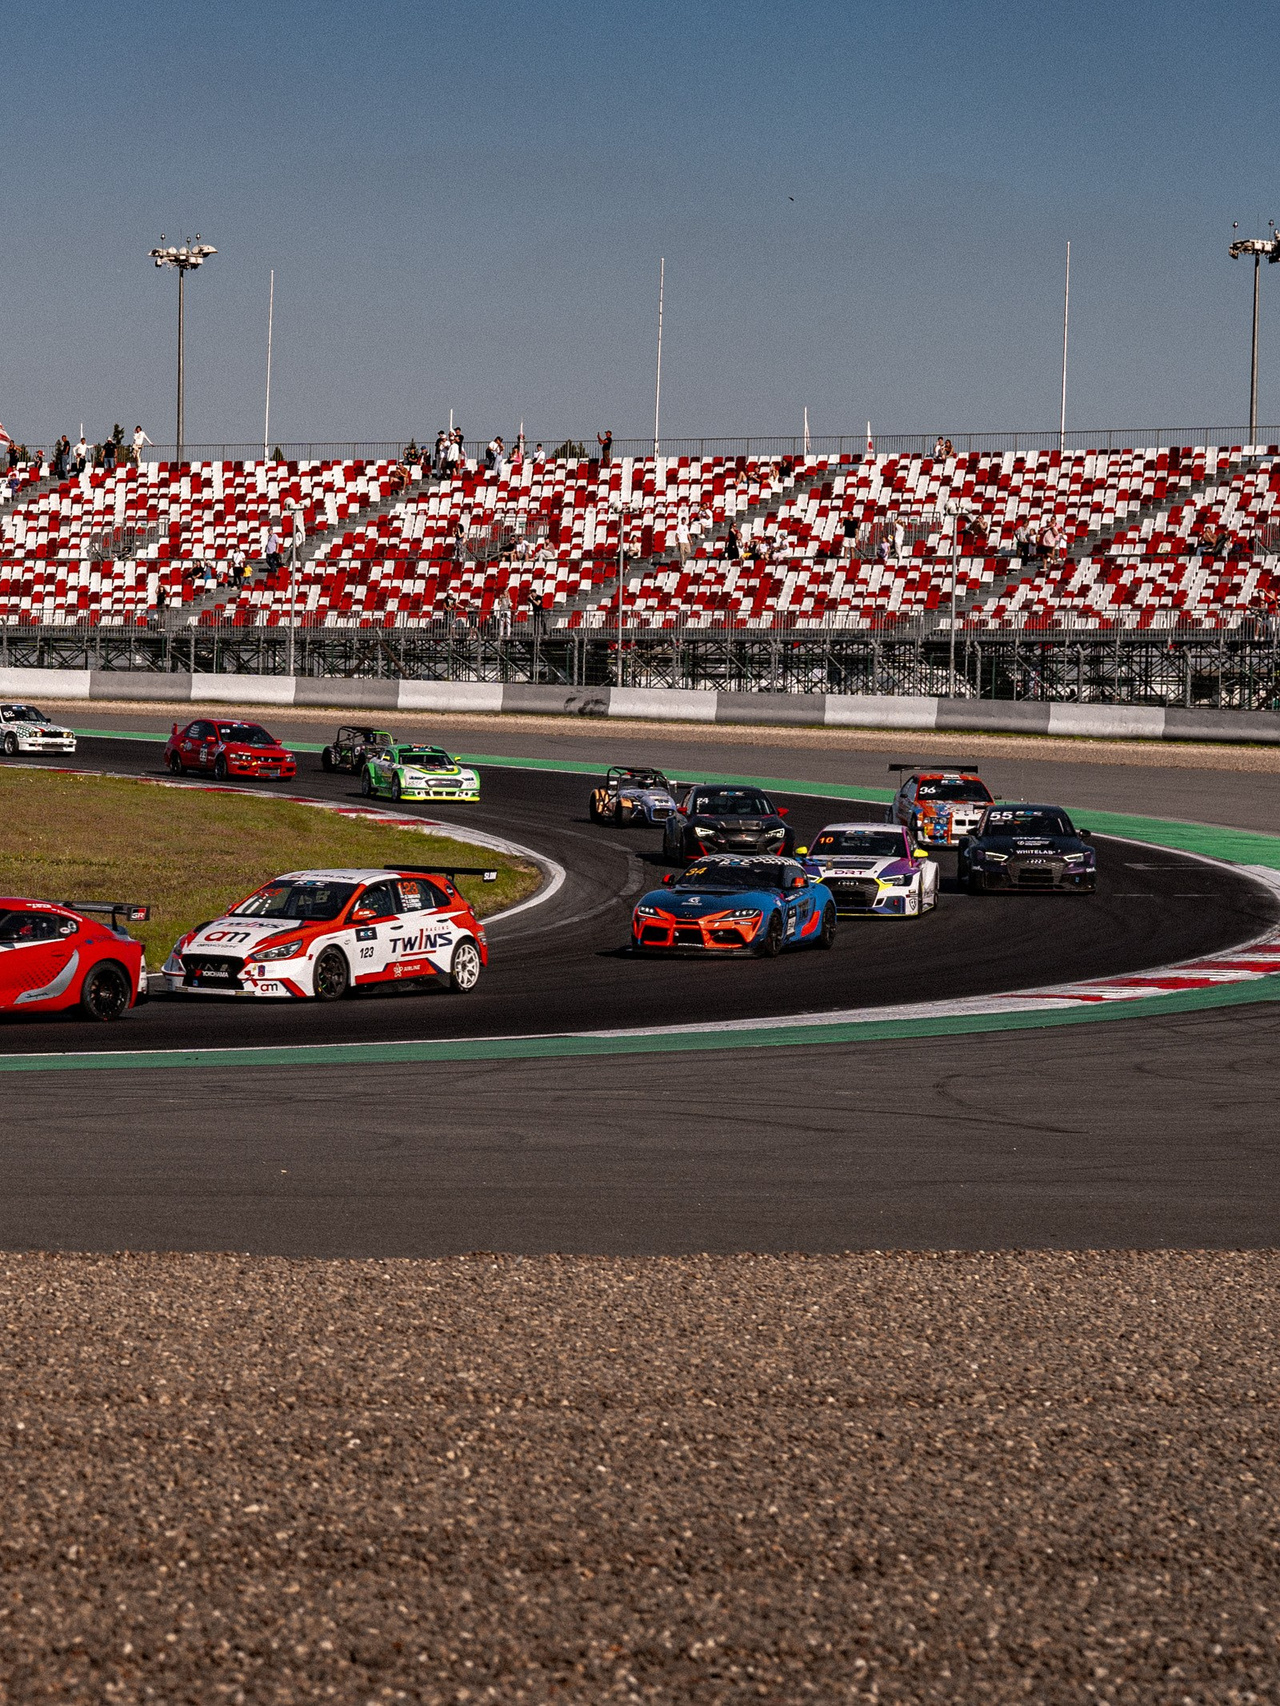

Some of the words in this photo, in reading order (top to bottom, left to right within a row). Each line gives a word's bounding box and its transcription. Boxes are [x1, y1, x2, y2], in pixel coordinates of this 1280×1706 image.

[919, 786, 936, 795] 36
[989, 811, 1013, 820] 55
[686, 867, 708, 876] 34
[397, 881, 419, 895] 123
[131, 912, 145, 920] GR
[204, 931, 251, 943] am
[389, 929, 453, 953] TWINS
[360, 946, 375, 959] 123
[202, 970, 229, 978] YOKOHAMA
[260, 982, 278, 992] am
